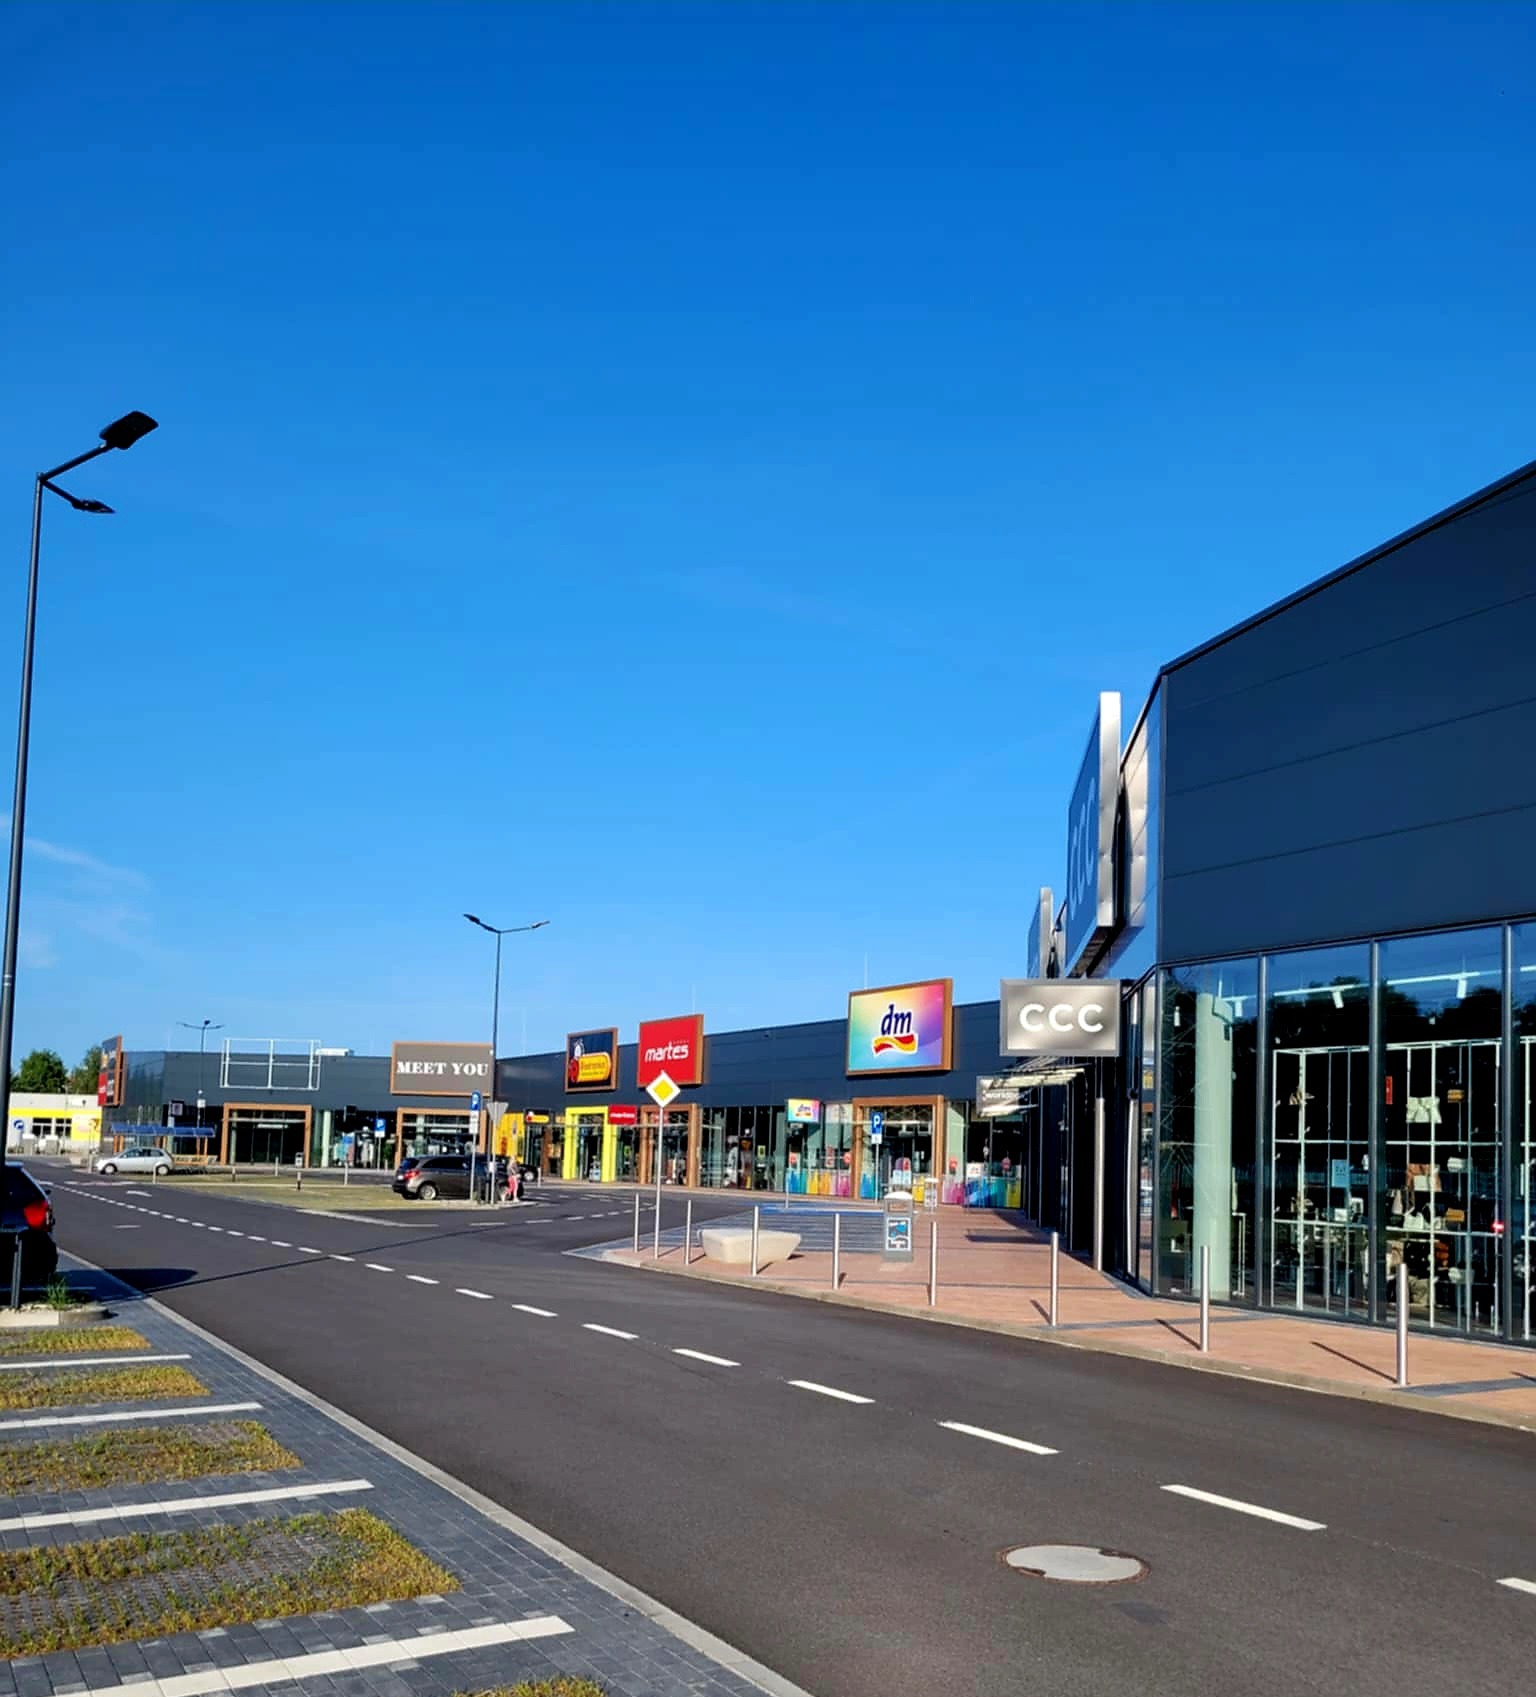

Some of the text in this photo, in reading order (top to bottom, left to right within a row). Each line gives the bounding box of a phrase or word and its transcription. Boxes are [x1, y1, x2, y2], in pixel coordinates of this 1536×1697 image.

[1069, 777, 1095, 921] CCC
[881, 1003, 912, 1035] dm
[1019, 1003, 1103, 1033] CCC
[644, 1040, 689, 1063] martes
[397, 1061, 488, 1076] MEET YOU
[873, 1115, 881, 1126] P
